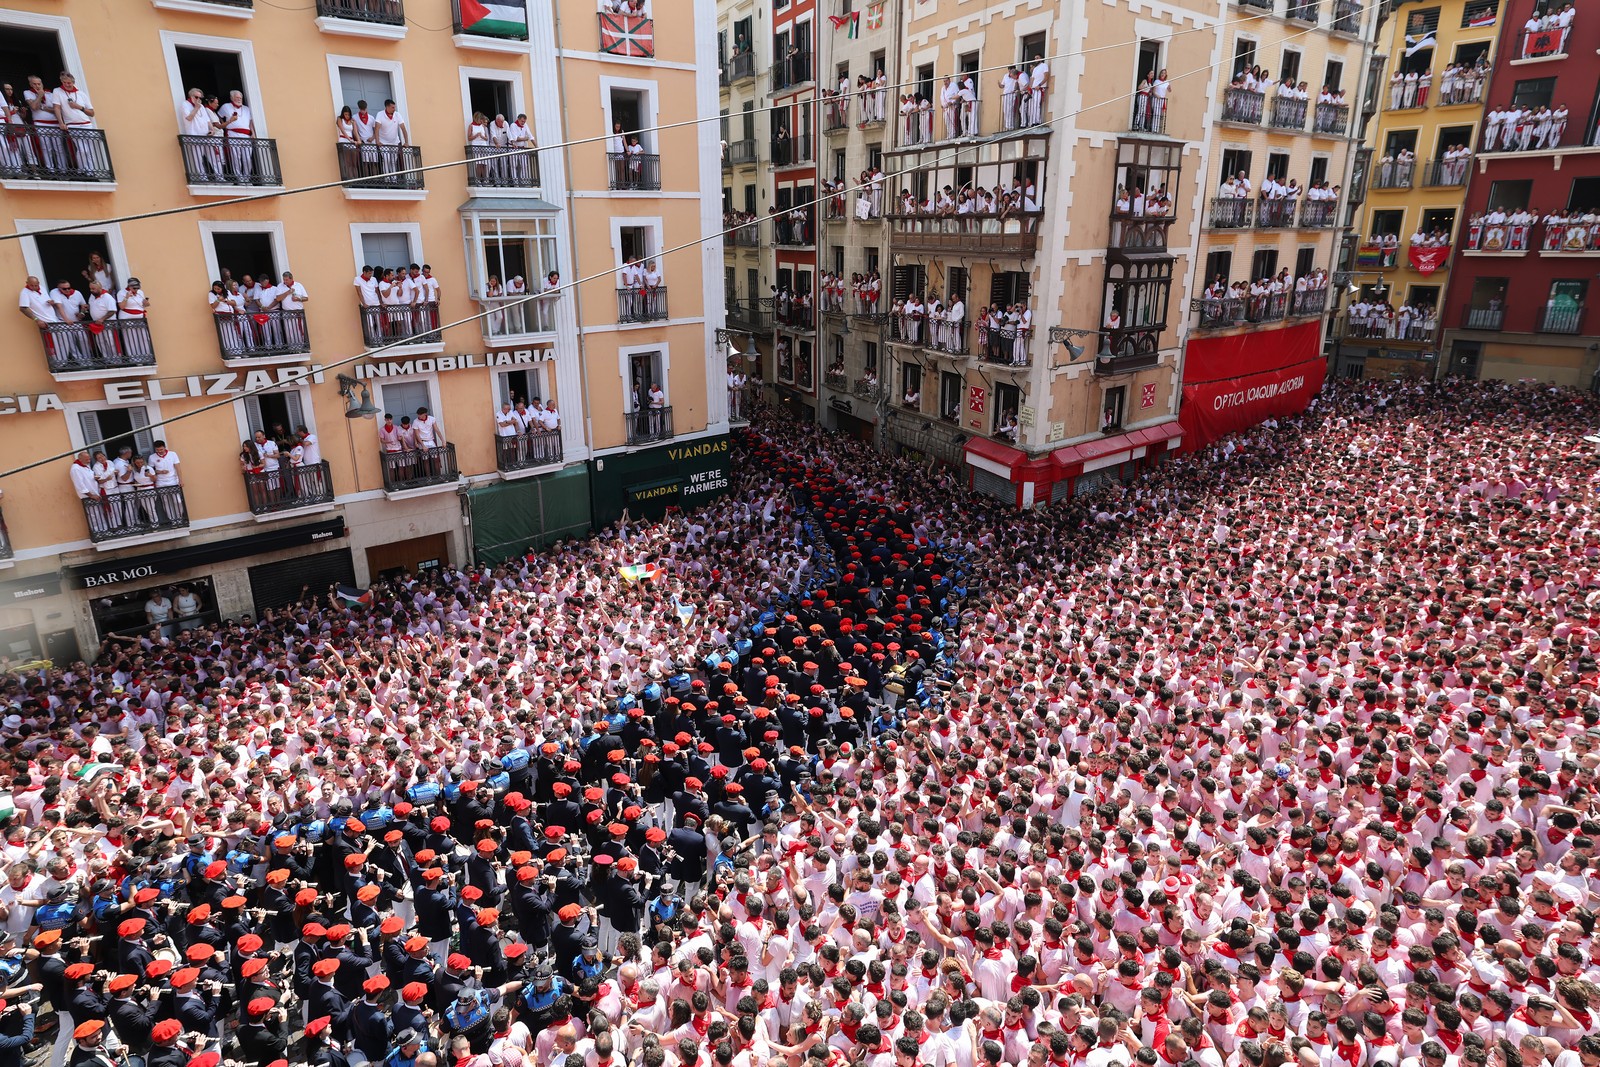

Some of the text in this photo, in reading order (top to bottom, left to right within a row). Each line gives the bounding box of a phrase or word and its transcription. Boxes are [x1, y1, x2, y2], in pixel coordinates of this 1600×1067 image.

[103, 364, 325, 405] ELIZARI
[355, 348, 559, 380] INMOBILIARIA
[1213, 391, 1244, 411] OPTICA
[1245, 383, 1278, 403] JOAQUIN
[668, 440, 728, 460] VIANDAS
[635, 484, 678, 500] VIANDAS
[683, 478, 728, 495] FARMERS
[311, 531, 334, 540] Mahou
[408, 522, 416, 532] 2
[84, 565, 158, 588] BAR MOL
